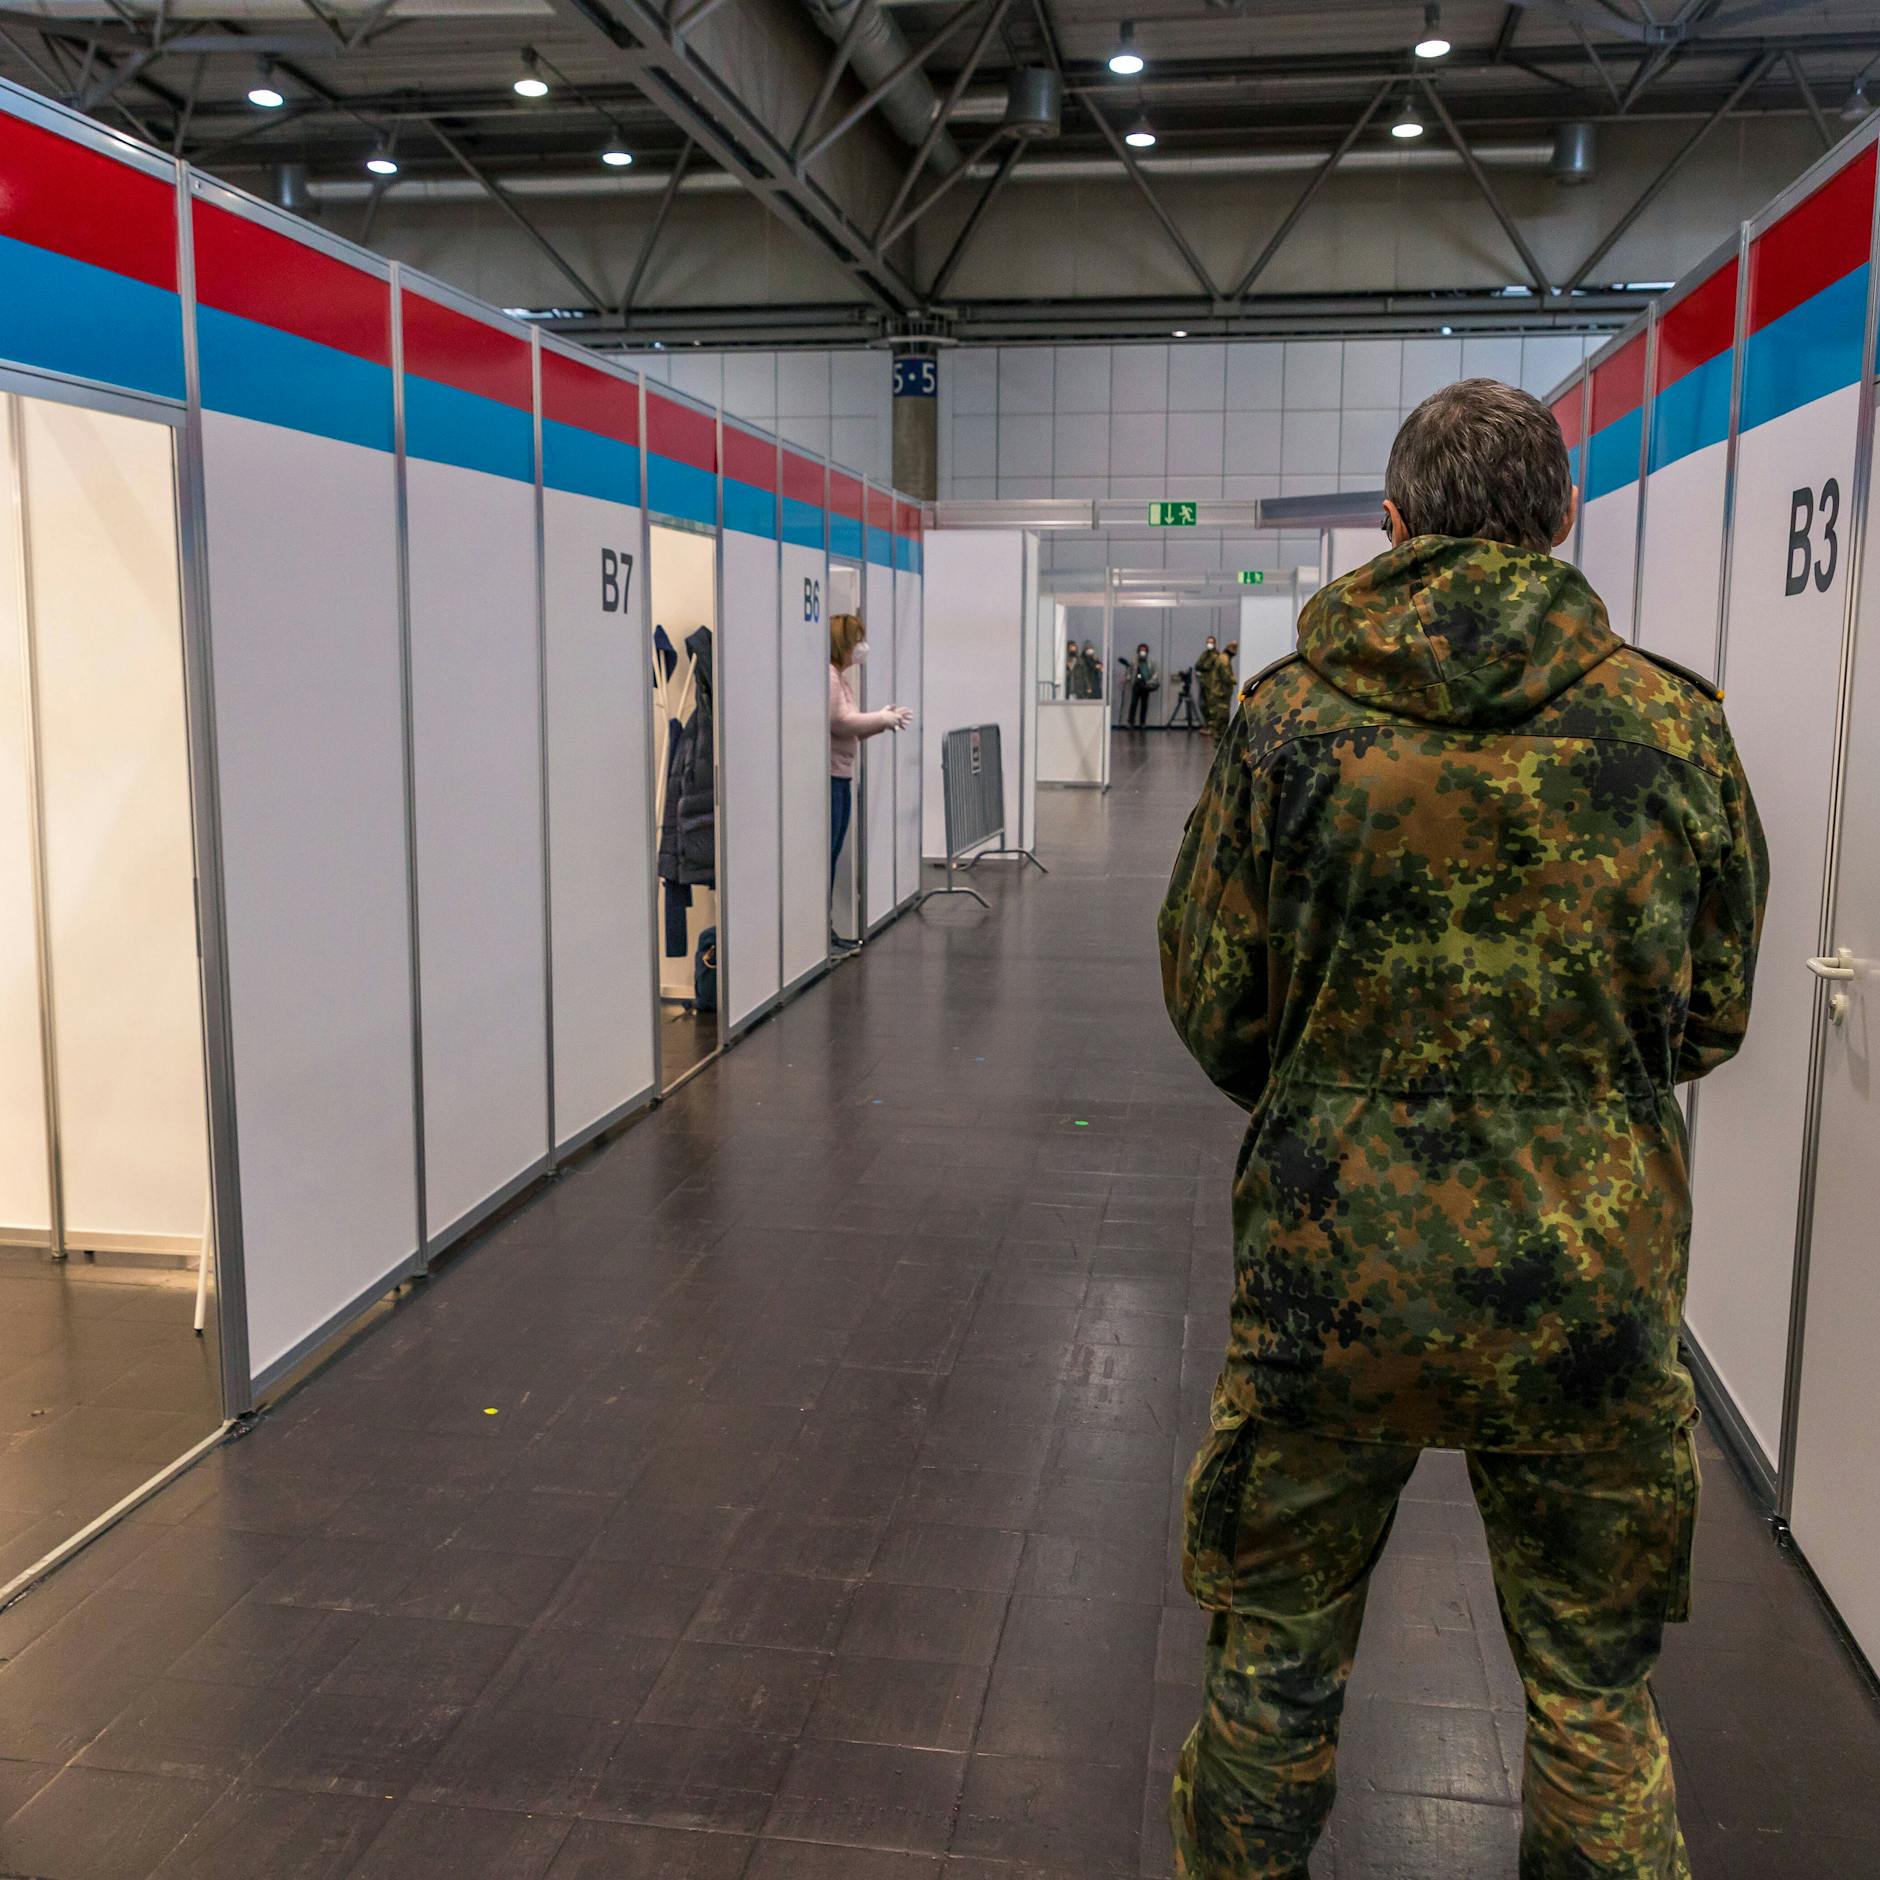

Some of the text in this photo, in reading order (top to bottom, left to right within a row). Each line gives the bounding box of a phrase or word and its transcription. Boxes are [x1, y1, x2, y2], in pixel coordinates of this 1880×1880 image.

[1785, 477, 1840, 597] B3
[601, 547, 634, 614] B7
[803, 577, 820, 623] B6
